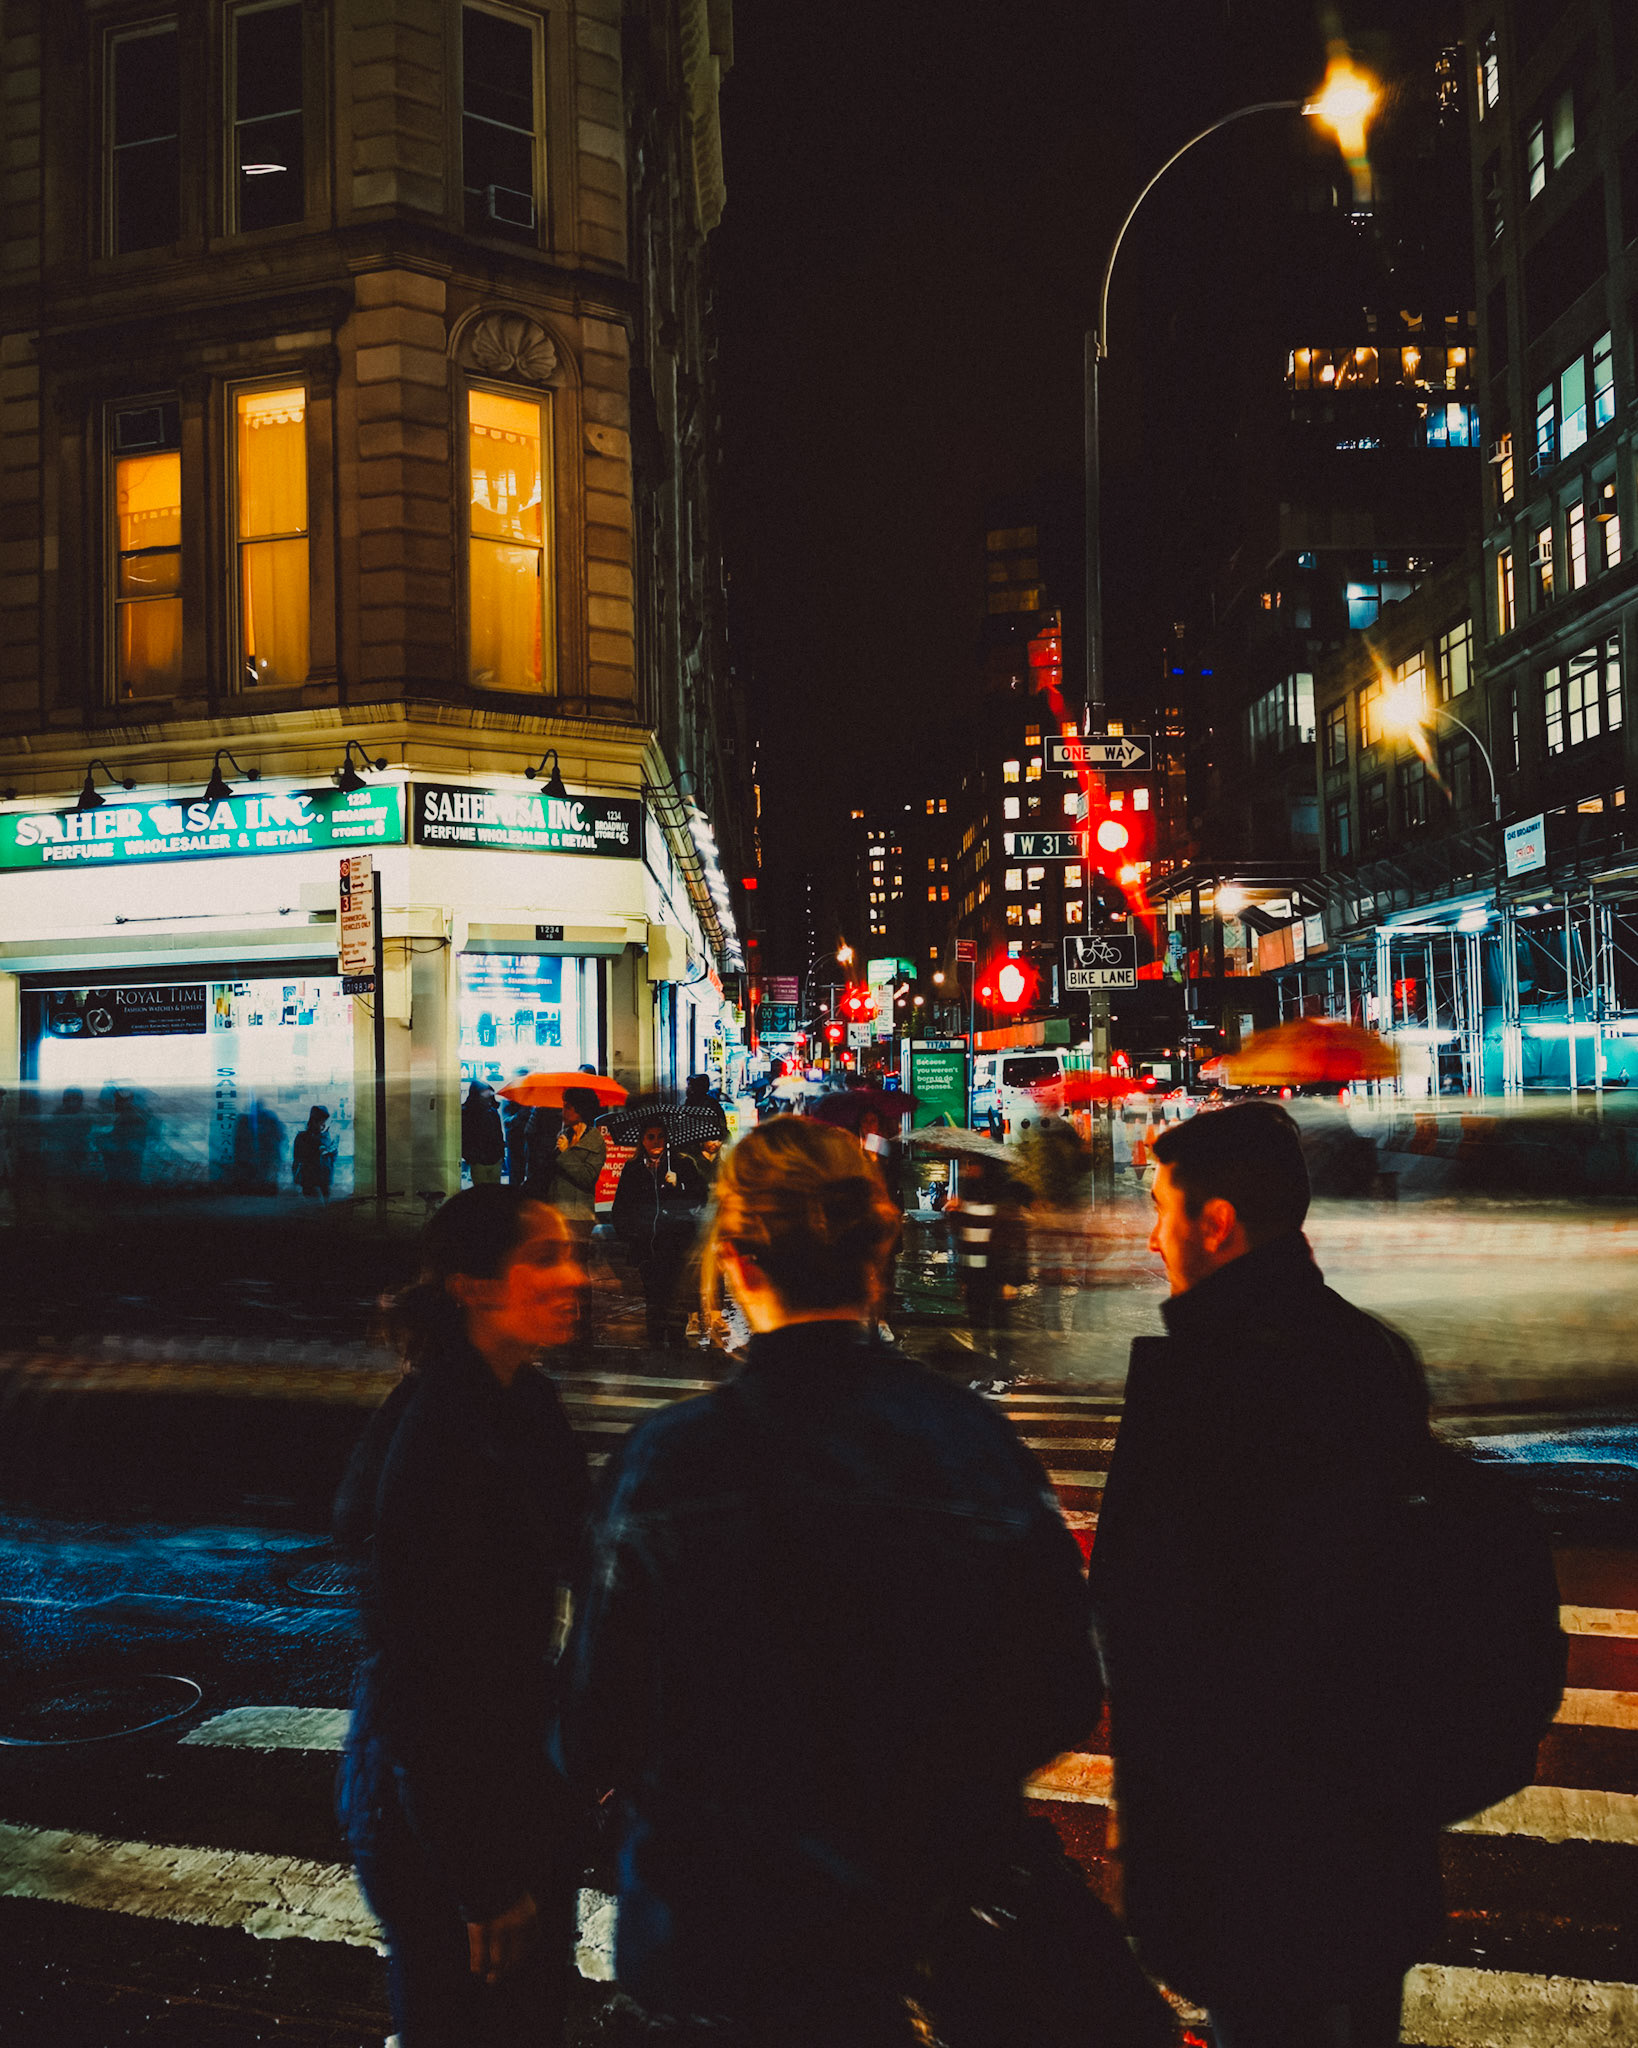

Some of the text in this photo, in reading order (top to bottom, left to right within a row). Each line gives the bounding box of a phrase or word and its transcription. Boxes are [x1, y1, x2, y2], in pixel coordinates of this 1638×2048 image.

[1061, 746, 1135, 760] ONE WAY
[15, 808, 144, 847] SAHER
[244, 795, 325, 831] INC.
[548, 799, 591, 832] INC.
[606, 810, 622, 821] 1234
[594, 819, 630, 833] BROADWAY
[423, 824, 599, 849] PERFUME WHOLESALER & RETAIL
[594, 830, 616, 840] STORE
[42, 829, 314, 862] PERFUME WHOLESALER & RETAIL
[1020, 834, 1079, 855] W 31 ST
[342, 913, 368, 923] COMMERCIAL
[343, 921, 371, 931] VEHICLES ONLY
[540, 926, 560, 934] 1234
[1070, 970, 1133, 985] BIKE LANE
[115, 987, 206, 1005] ROYAL TIME
[925, 1041, 951, 1049] TITAN
[916, 1074, 934, 1082] born
[943, 1074, 954, 1082] do
[916, 1084, 954, 1092] expenses.
